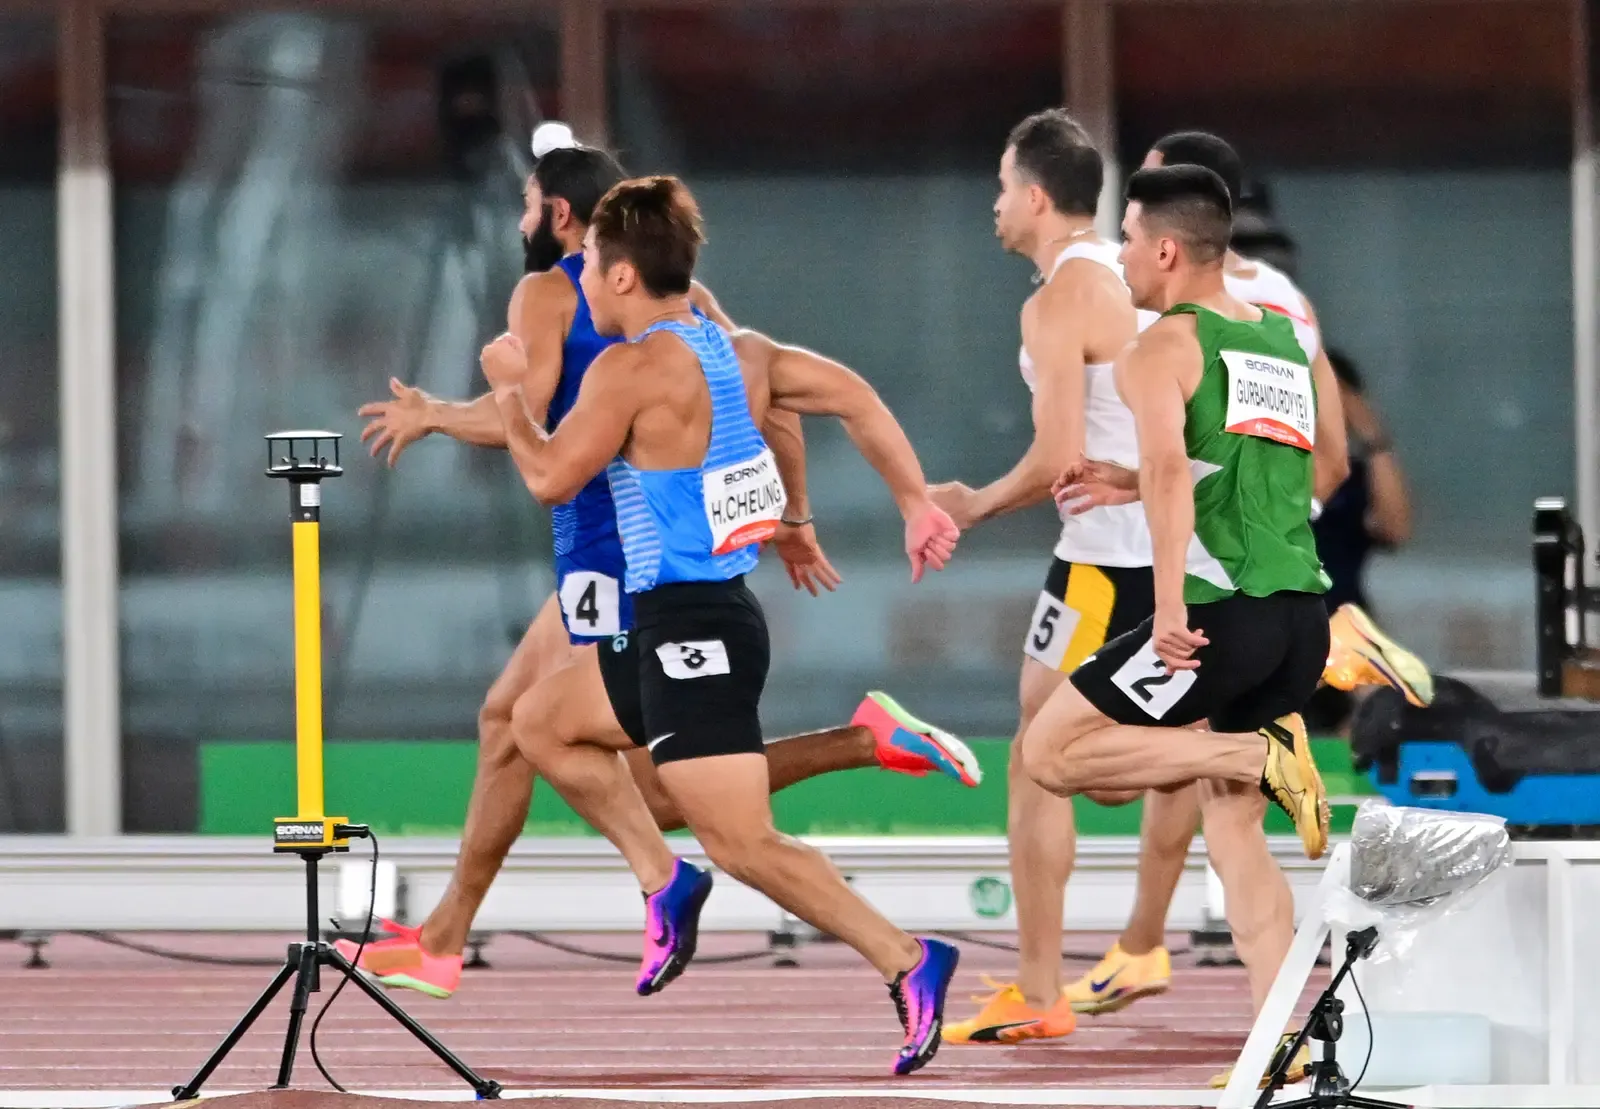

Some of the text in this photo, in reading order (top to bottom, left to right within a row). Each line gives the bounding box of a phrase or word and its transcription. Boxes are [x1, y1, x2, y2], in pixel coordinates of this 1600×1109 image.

[1244, 359, 1294, 379] BORNAN
[711, 478, 782, 527] H.CHEUNG
[576, 580, 599, 627] 4
[1033, 606, 1061, 651] 5
[1129, 659, 1175, 704] 2
[275, 825, 324, 835] BORNAN
